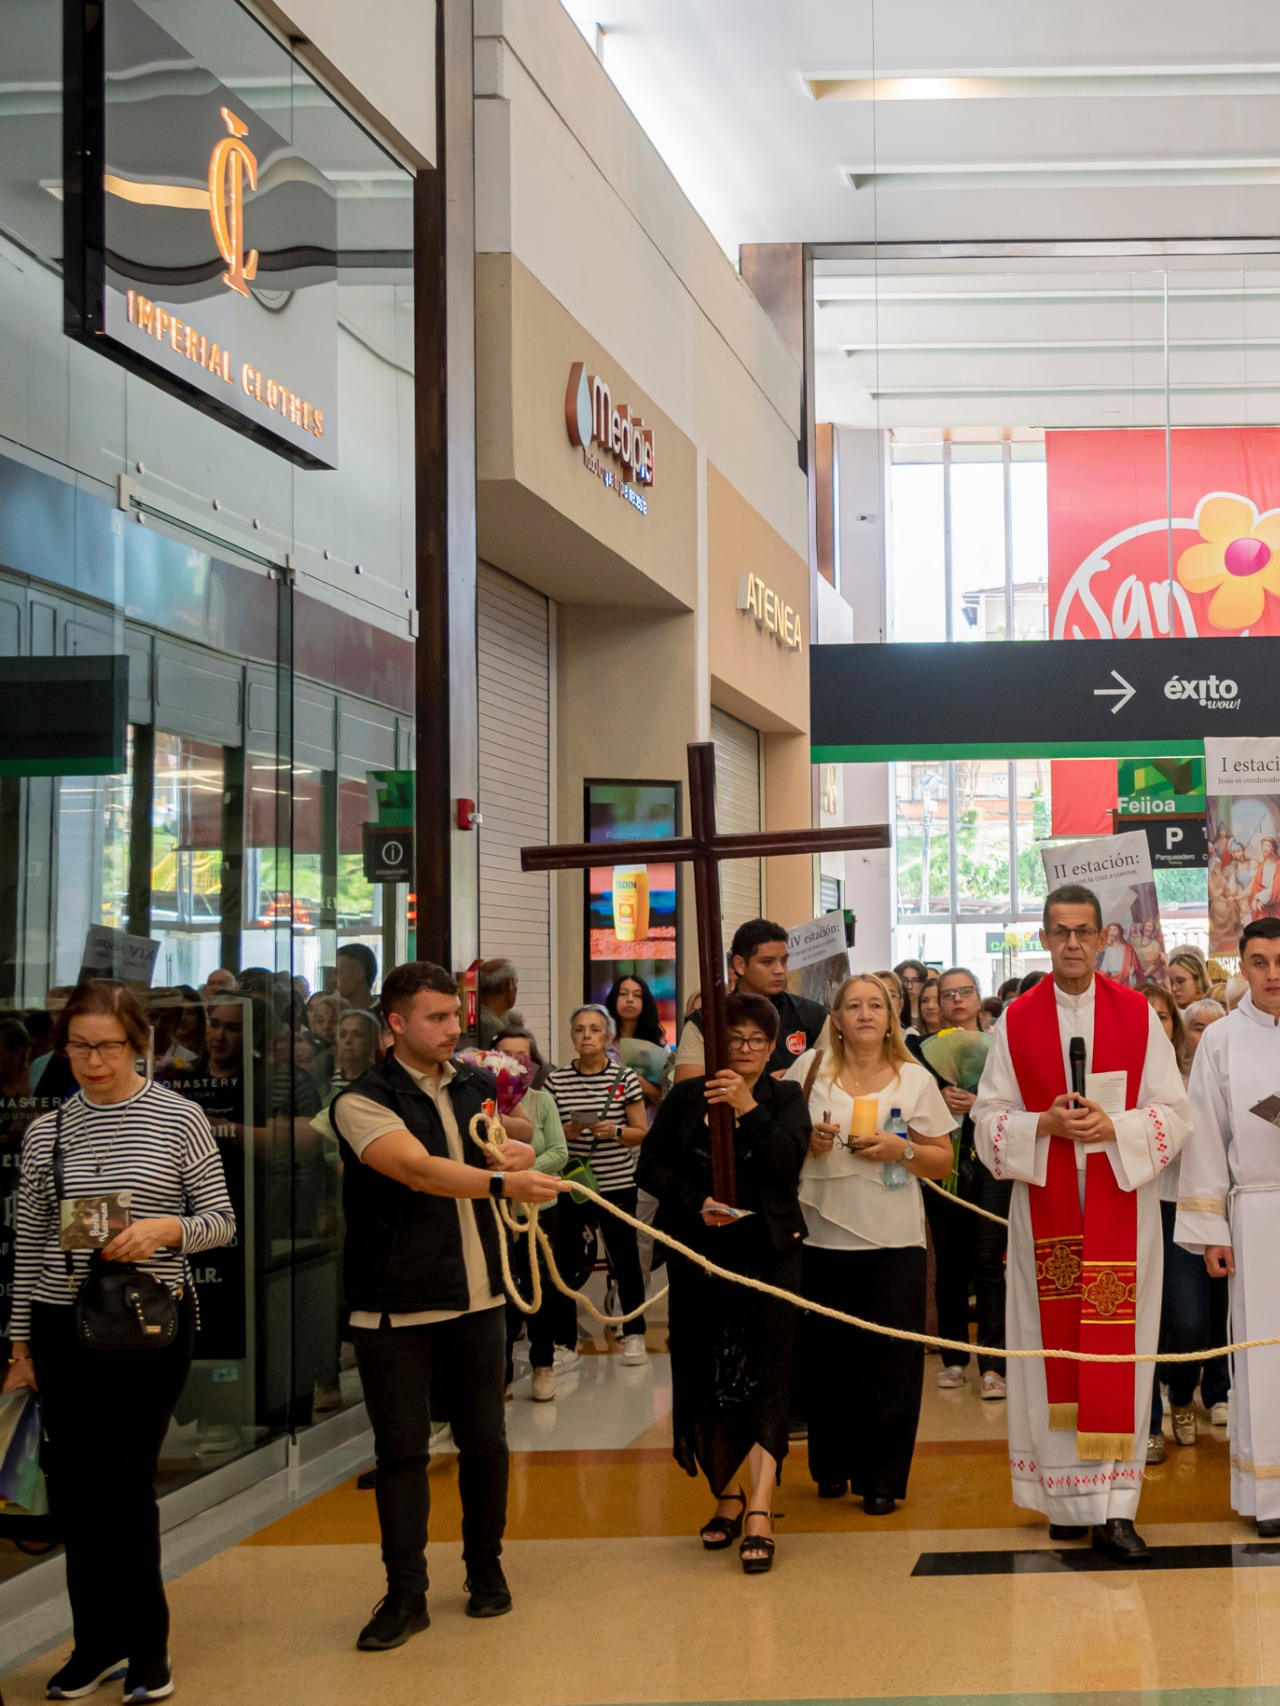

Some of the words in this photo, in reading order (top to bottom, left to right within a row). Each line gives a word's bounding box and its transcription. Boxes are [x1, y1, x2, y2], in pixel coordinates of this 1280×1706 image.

[127, 288, 235, 385] IMPERIAL
[241, 362, 325, 438] CLOTHES
[1072, 558, 1199, 639] San
[744, 572, 803, 653] ATENEA
[1163, 674, 1239, 706] éxito
[1207, 698, 1242, 710] wow!
[1221, 757, 1228, 773] I
[1243, 776, 1280, 784] condenado
[1117, 796, 1176, 814] Feijoa
[1165, 827, 1184, 850] P
[1053, 863, 1067, 880] II
[1072, 852, 1140, 877] estación:
[1155, 853, 1196, 862] Parqueadero
[804, 922, 840, 945] estación:
